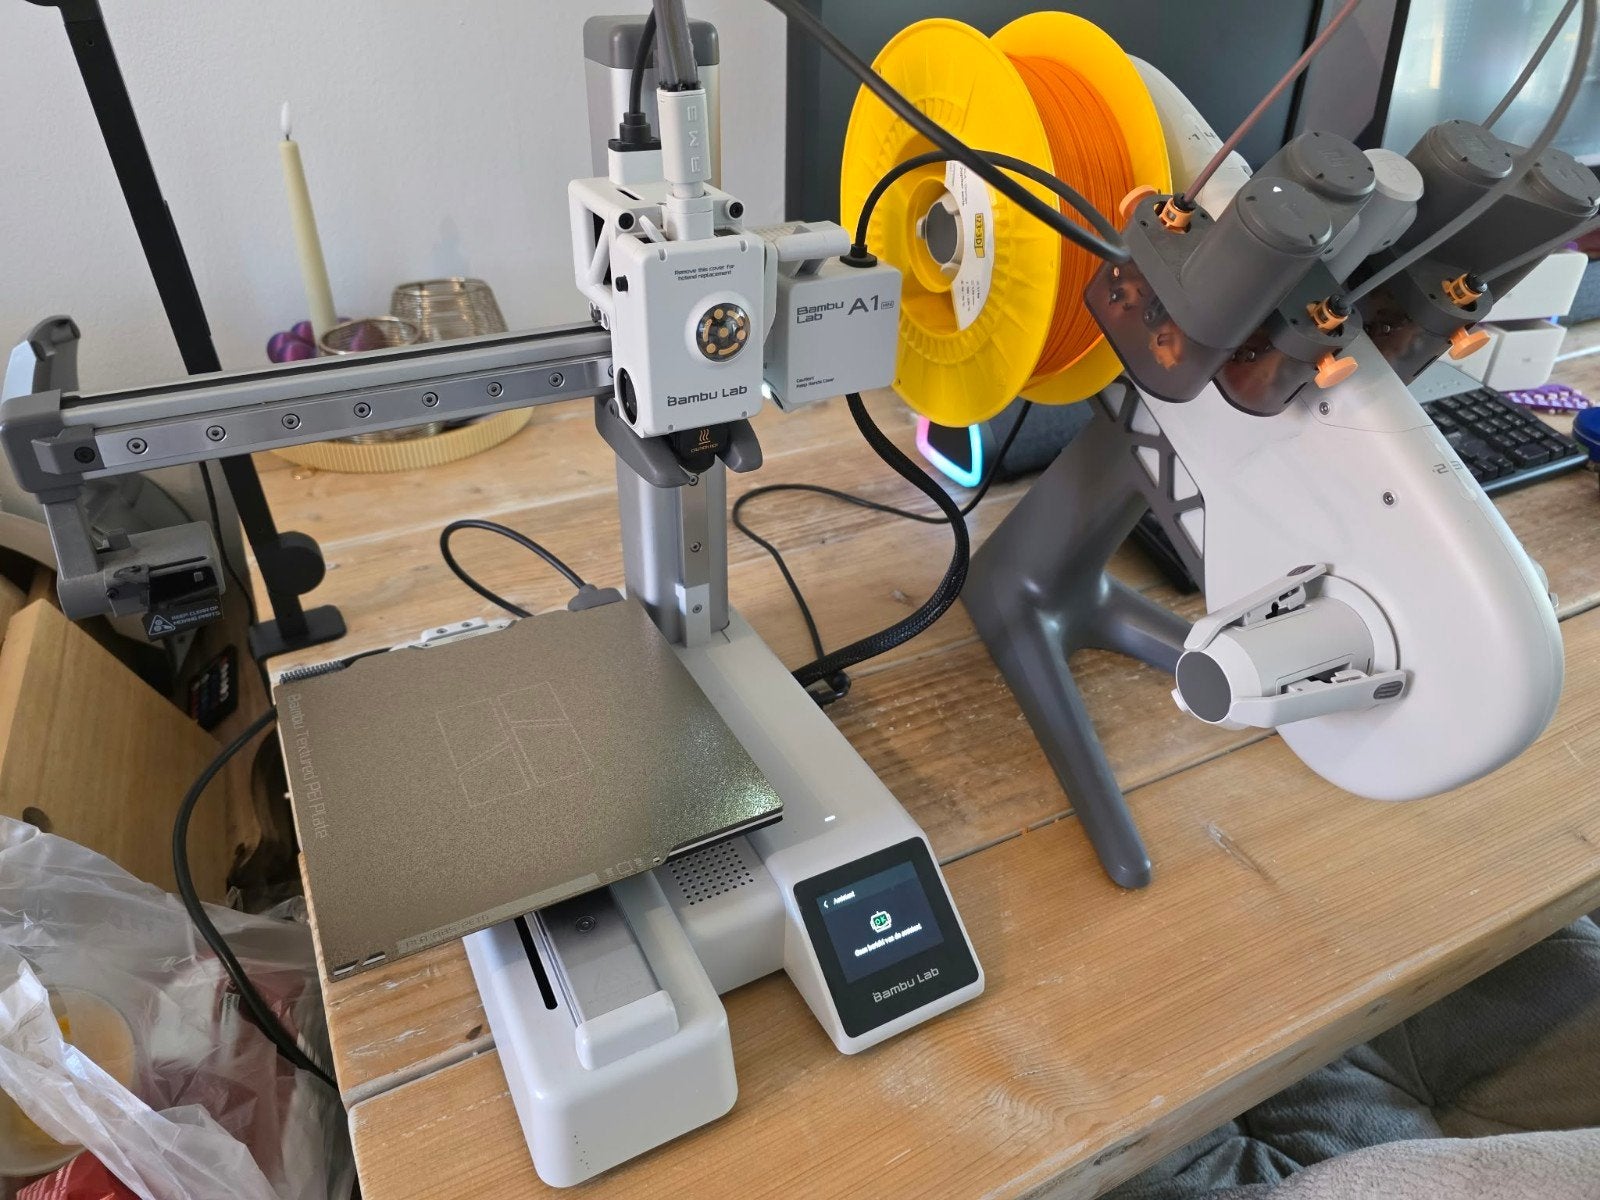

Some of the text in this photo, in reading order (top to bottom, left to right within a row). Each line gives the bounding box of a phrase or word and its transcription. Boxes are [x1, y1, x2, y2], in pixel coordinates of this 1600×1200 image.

[687, 106, 701, 173] AMS
[697, 270, 731, 279] replacement
[796, 301, 845, 316] Bambu
[847, 294, 879, 316] A1
[796, 313, 823, 324] Lab
[667, 385, 748, 407] Bambu Lab
[171, 612, 189, 621] KEEP
[189, 608, 209, 616] CLEAR
[173, 611, 221, 625] MOVING PARTS
[287, 693, 331, 839] Bambu Textured PEI Plate
[872, 967, 940, 1003] Bambu Lab
